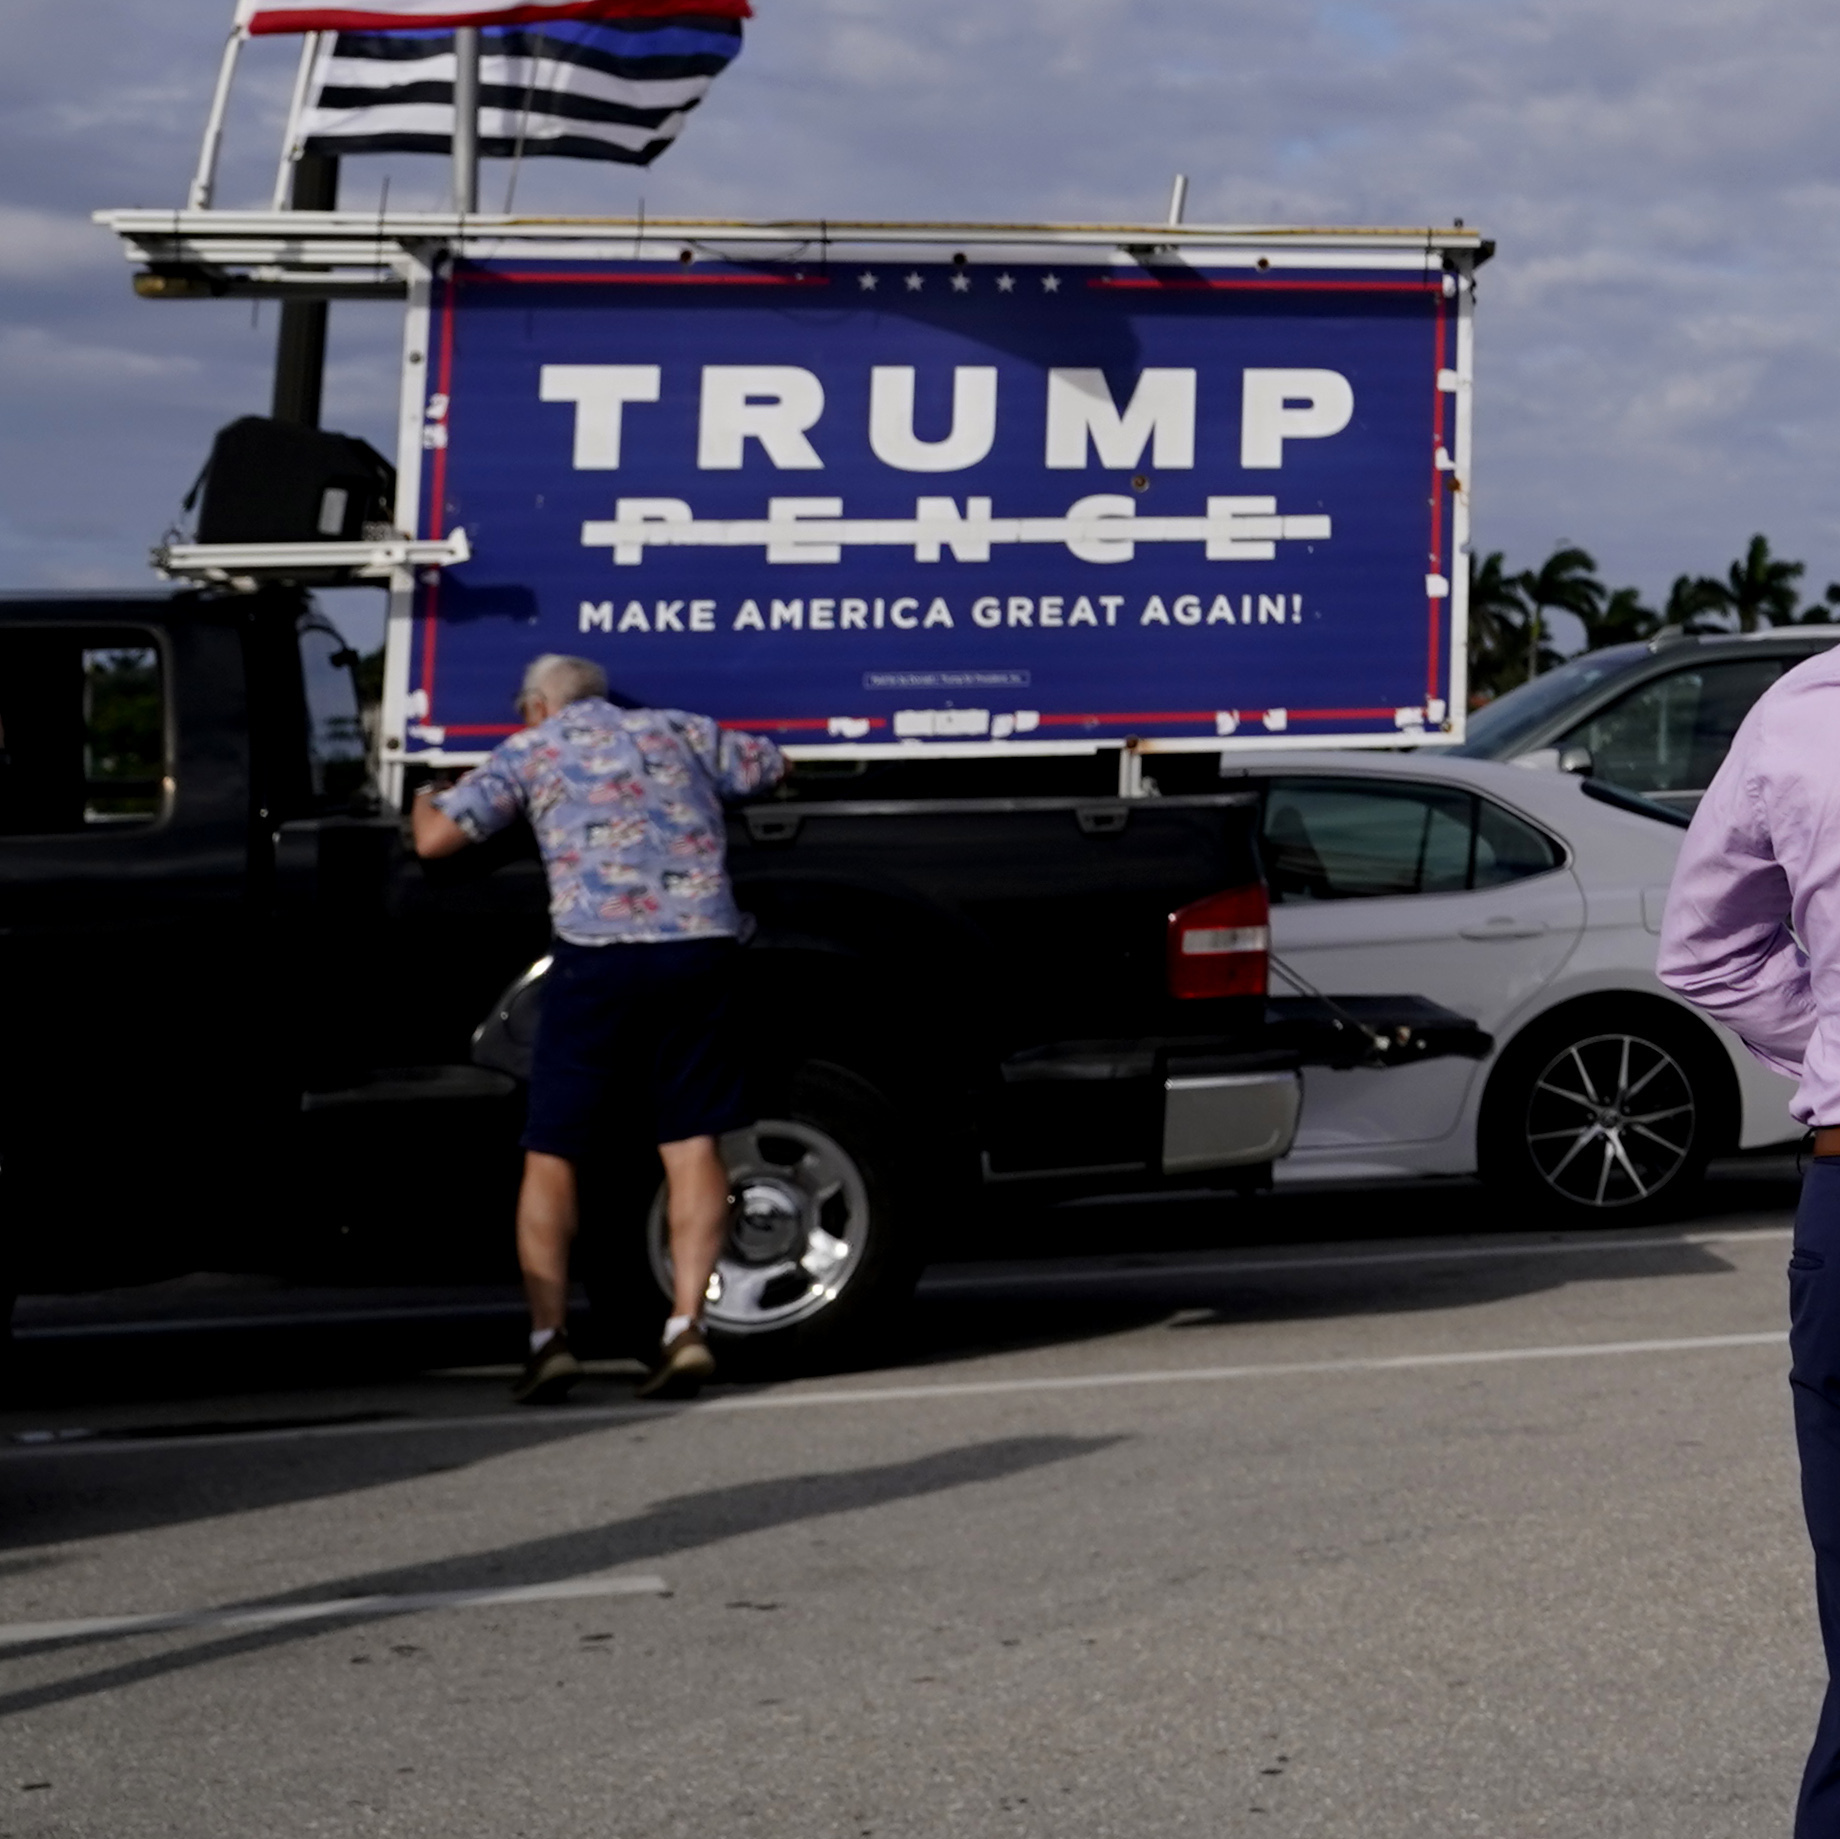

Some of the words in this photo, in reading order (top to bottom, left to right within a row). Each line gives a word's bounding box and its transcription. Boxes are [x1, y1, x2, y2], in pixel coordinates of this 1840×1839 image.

[539, 364, 1355, 472] TRUMP
[578, 599, 717, 633] MAKE
[732, 597, 954, 630] AMERICA
[971, 595, 1124, 628] GREAT
[1140, 593, 1303, 626] AGAIN!
